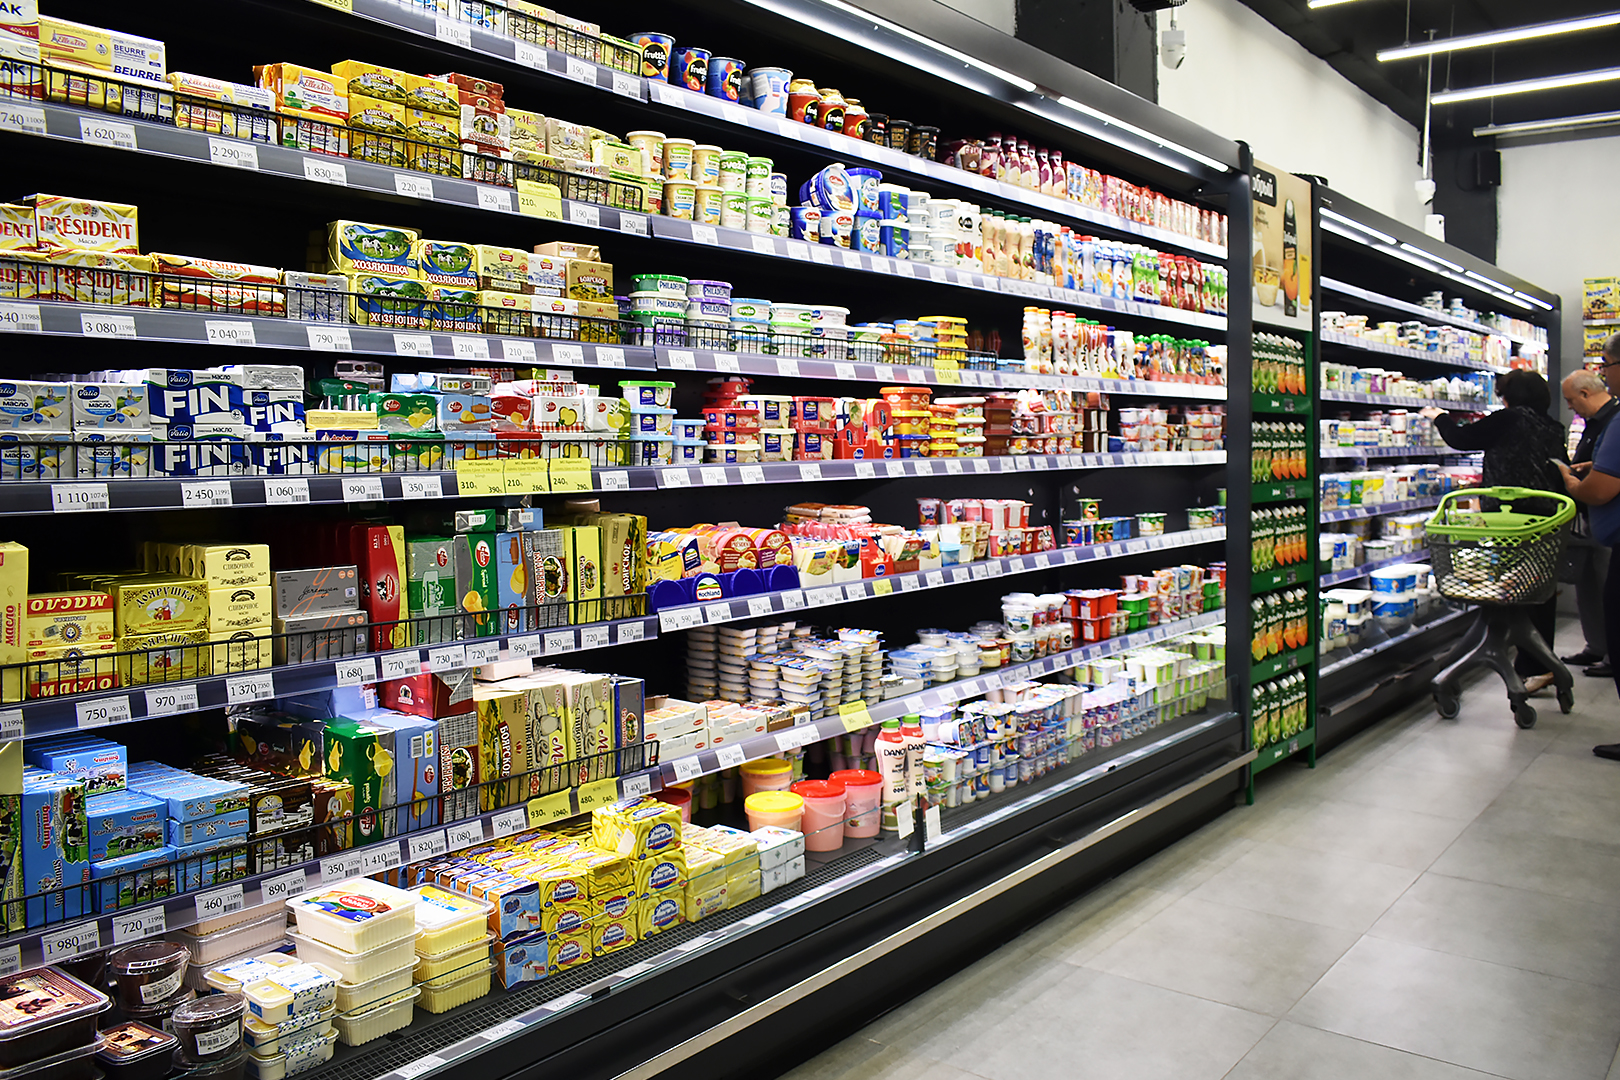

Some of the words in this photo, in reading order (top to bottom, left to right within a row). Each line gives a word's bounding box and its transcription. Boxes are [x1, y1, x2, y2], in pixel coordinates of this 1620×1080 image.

[439, 24, 442, 35] 1
[446, 26, 459, 39] 110
[113, 44, 146, 56] BEURRE
[520, 50, 534, 61] 210
[644, 50, 666, 60] Fruttis
[113, 65, 162, 82] BEURRE
[572, 65, 584, 75] 190
[617, 81, 629, 91] 250
[1, 113, 24, 126] 740
[83, 127, 92, 138] 4
[94, 128, 116, 140] 620
[212, 146, 219, 157] 2
[221, 147, 240, 159] 290
[306, 167, 311, 176] 1
[314, 168, 332, 179] 830
[401, 181, 417, 192] 220
[1252, 174, 1274, 198] обрый
[484, 193, 498, 205] 230
[521, 198, 534, 207] 210
[575, 209, 587, 219] 190
[39, 214, 132, 240] PRÉSIDENT
[625, 220, 636, 229] 250
[352, 259, 409, 276] ХОЗЯЮШКА
[426, 273, 477, 287] ХОЗЯЮШКА
[370, 311, 425, 327] ХОЗЯЮШКА
[86, 323, 93, 333] 3
[95, 323, 117, 335] 080
[209, 329, 217, 339] 2
[219, 329, 238, 340] 040
[315, 334, 333, 345] 790
[400, 341, 416, 351] 390
[459, 344, 474, 353] 210
[509, 348, 522, 357] 210
[558, 351, 571, 360] 190
[601, 352, 614, 362] 210
[170, 375, 188, 384] Valio
[77, 388, 99, 398] Valio
[163, 385, 230, 417] FIN
[250, 402, 295, 426] FIN
[171, 428, 189, 437] Valio
[164, 441, 232, 471] FIN
[263, 444, 309, 467] FIN
[461, 481, 476, 490] 310
[507, 479, 521, 488] 210
[553, 478, 566, 487] 240
[605, 477, 617, 487] 270
[268, 487, 272, 497] 1
[276, 487, 294, 497] 060
[349, 485, 366, 496] 990
[408, 483, 424, 494] 350
[57, 493, 62, 503] 1
[68, 492, 89, 503] 110
[185, 490, 192, 500] 2
[195, 490, 214, 501] 450
[622, 542, 632, 592] БОЯРСКОЕ
[136, 586, 196, 609] ДОЯРУШКА
[697, 588, 722, 599] Hochland
[30, 595, 108, 612] масло
[710, 609, 722, 618] 800
[664, 616, 676, 626] 590
[680, 614, 692, 624] 590
[586, 634, 598, 643] 720
[622, 629, 634, 638] 510
[513, 644, 527, 653] 950
[550, 639, 562, 649] 550
[435, 655, 450, 665] 730
[471, 649, 486, 660] 720
[388, 660, 404, 672] 770
[340, 669, 344, 679] 1
[347, 667, 363, 678] 680
[231, 685, 235, 696] 1
[237, 683, 257, 695] 370
[155, 696, 176, 708] 970
[180, 694, 197, 702] 11021
[85, 708, 108, 721] 750
[112, 705, 127, 713] 9135
[525, 714, 533, 773] СЛИВОЧНЫ
[907, 742, 926, 751] DANO
[499, 725, 512, 778] БОЯРСКОЕ
[721, 752, 732, 761] 180
[883, 747, 906, 757] DANO
[680, 764, 689, 773] 180
[630, 783, 641, 793] 400
[580, 796, 593, 805] 480
[602, 796, 613, 804] 540
[530, 810, 544, 819] 930
[553, 810, 567, 818] 1040
[498, 820, 512, 830] 990
[450, 834, 454, 843] 1
[456, 831, 471, 843] 080
[412, 844, 417, 854] 1
[418, 841, 434, 853] 820
[365, 857, 369, 867] 1
[371, 854, 387, 866] 410
[328, 862, 345, 875] 350
[268, 883, 286, 896] 890
[226, 892, 242, 901] 11995
[204, 897, 223, 911] 460
[121, 921, 143, 935] 720
[80, 932, 98, 942] 11997
[47, 943, 53, 955] 1
[58, 937, 80, 952] 980
